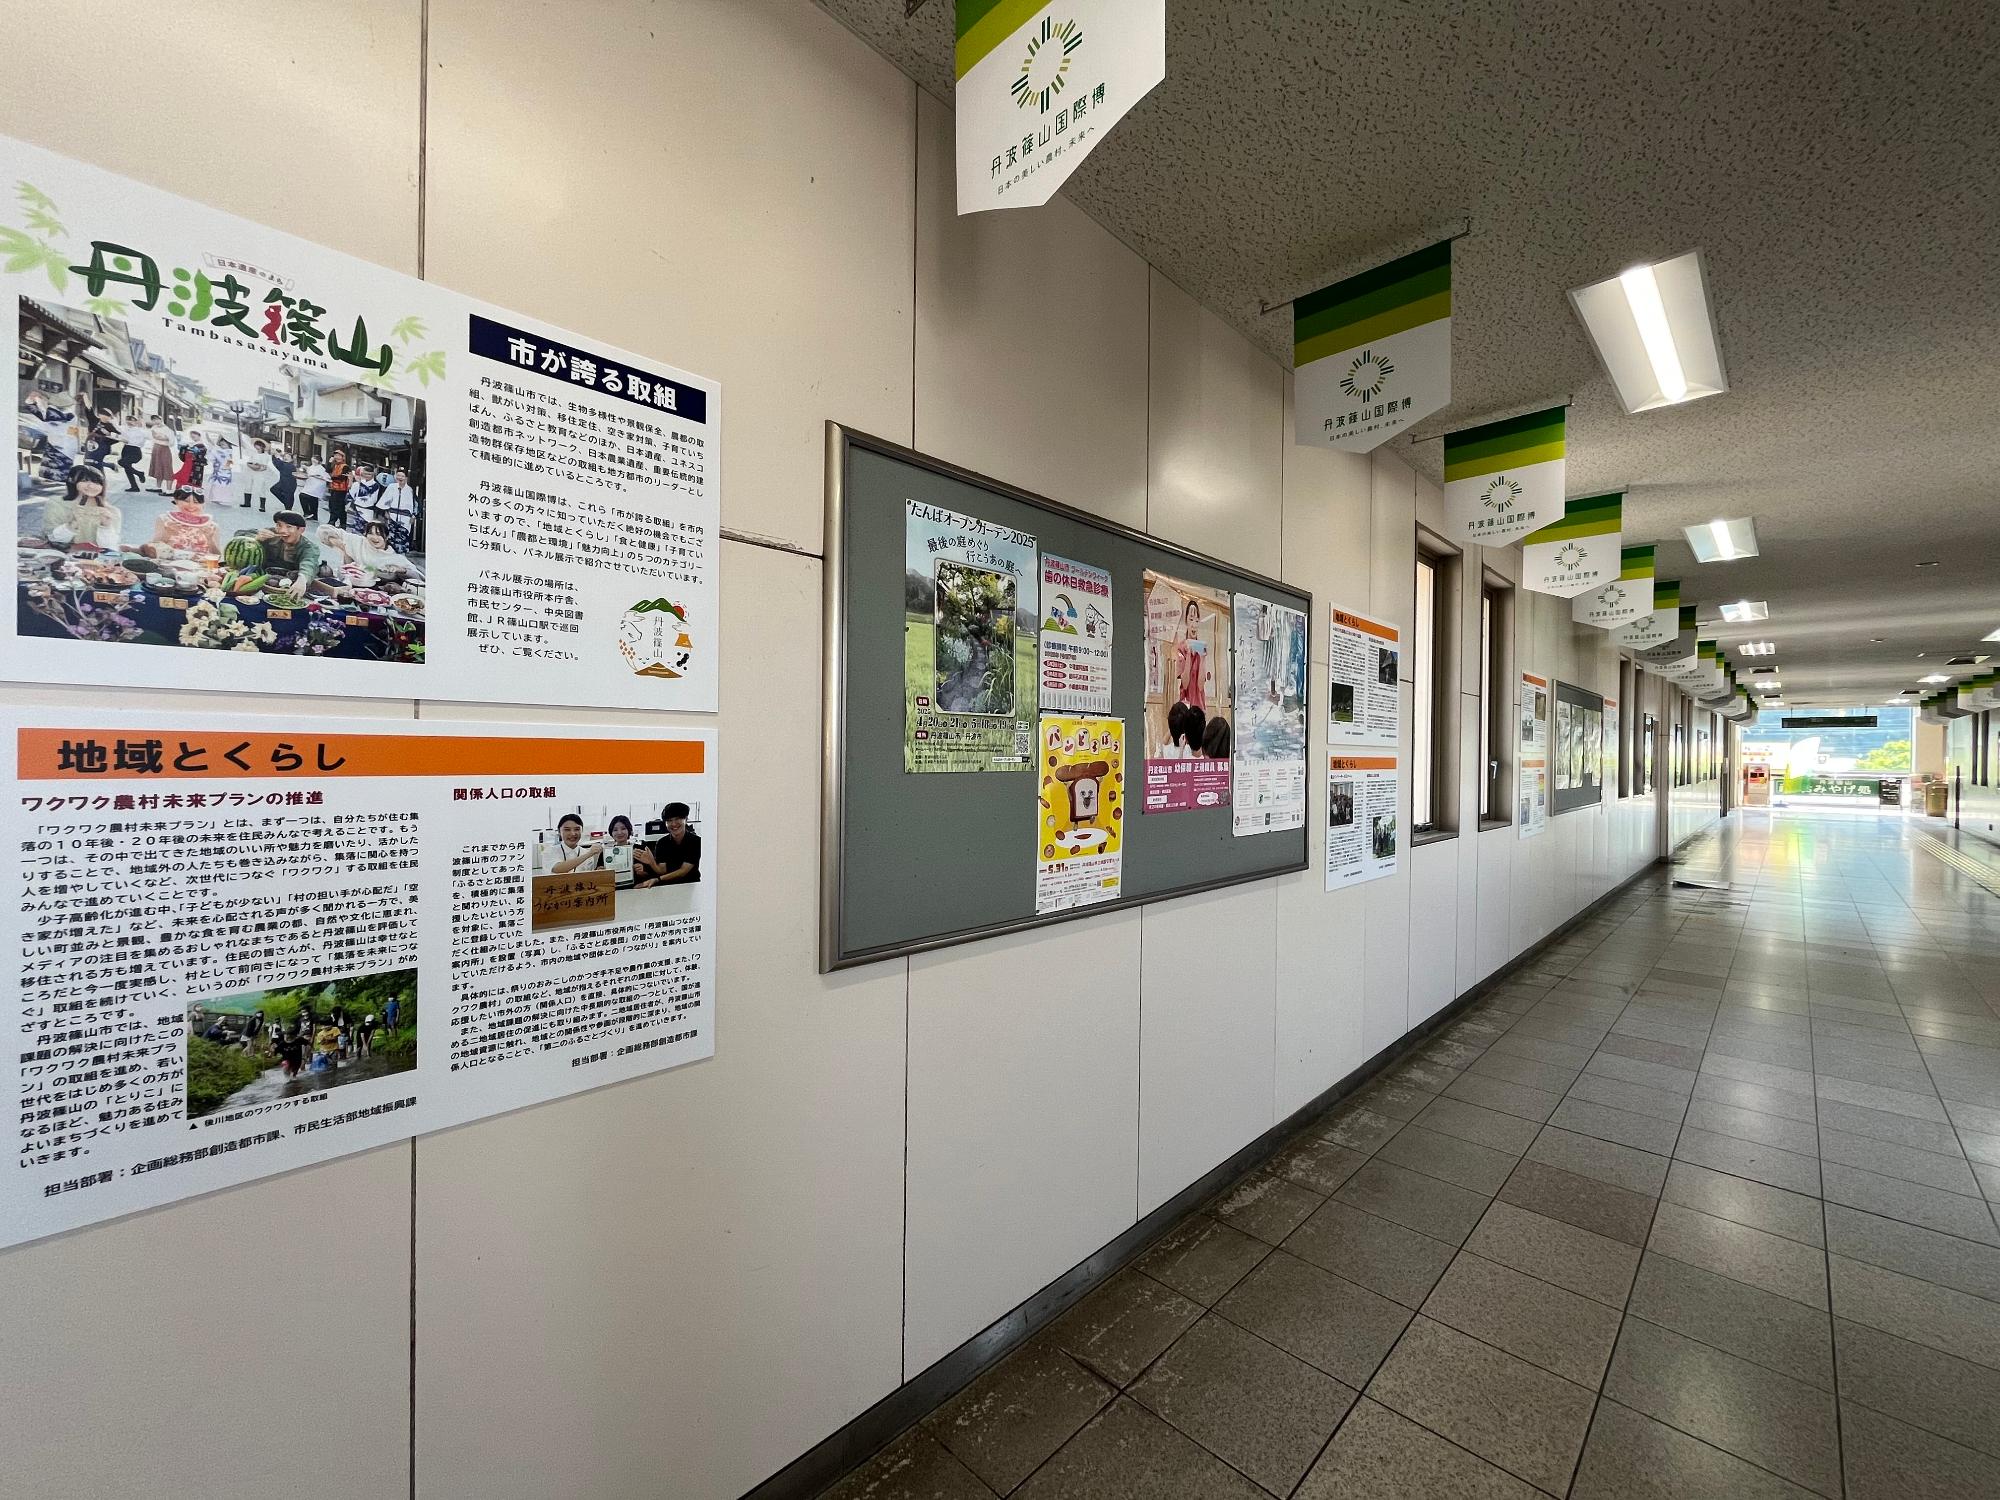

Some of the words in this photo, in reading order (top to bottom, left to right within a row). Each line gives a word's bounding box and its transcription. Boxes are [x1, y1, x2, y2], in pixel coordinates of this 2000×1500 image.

[991, 82, 1106, 179] 丹波篠山国際博
[997, 126, 1095, 195] 日本の美しい農村、未来へ
[217, 259, 284, 285] 日本遺産のまち
[68, 241, 394, 376] 丹波篠山
[162, 317, 330, 370] Tambasasayama
[508, 337, 678, 411] 市が誇る取組
[469, 387, 704, 460] 組、獣がい対策、移住定住、空き家対策、子育ていち
[480, 376, 704, 447] 丹波篠山市では、生物多様性や景観保全、農都の取
[1324, 397, 1412, 431] 丹波篠山国際博
[468, 418, 704, 486] 創造都市ネットワーク、日本農業遺産、重要伝統的建
[469, 402, 704, 473] ばん、ふるさと教育などのほか、日本遺産、ユネスコ
[468, 433, 704, 497] 造物群保存地区などの取組も地方都市のリーダーとし
[469, 449, 628, 493] て積極的に進めているところです。
[468, 493, 704, 547] 外の多くの方々に知っていただく絶好の機会でもござ
[479, 480, 704, 535] 丹波篠山国際博は、これら「市が誇る取組」を市内
[1468, 511, 1536, 530] 丹波篠山国際博
[910, 502, 1034, 548] たんばオープンガーデン2025
[468, 537, 704, 585] に分類し、パネル展示で紹介させていただいています。
[927, 535, 989, 553] 最後の庭めぐり
[966, 550, 1023, 576] 行こうあの庭へ
[468, 583, 580, 605] 丹波篠山市役所本庁舎、
[479, 570, 580, 592] パネル展示の場所は、
[1044, 569, 1109, 598] 歯の休日救急診療
[468, 598, 583, 620] 市民センター、中央図書
[467, 628, 549, 644] 展示しています。
[479, 644, 580, 661] ぜひ、ご覧ください。
[653, 616, 664, 658] 丹波篠山
[58, 739, 346, 774] 地域とくらし
[22, 791, 324, 811] ワクワク農村未来プランの推進
[453, 786, 557, 801] 関係人口の取組
[38, 813, 419, 835] 「ワクワク農村未来プラン」とは、まず一つは、自分たちが住む集
[21, 837, 419, 865] 一つは、その中で出てきた地域のいい所や魅力を磨いたり、活かした
[452, 853, 525, 866] 波篠山市のファン
[462, 842, 525, 853] これまでから丹
[22, 849, 419, 881] りすることで、地域外の人たちも巻き込みながら、集落に関心を持つ
[22, 860, 419, 897] 人を増やしていくなど、次世代につなぐ「ワクワク」する取組を住民
[452, 864, 525, 877] 制度としてあった
[452, 875, 525, 888] 「ふるさと応援団」
[21, 887, 218, 912] みんなで進めていくことです。
[452, 886, 525, 899] を、積極的に集落
[452, 897, 525, 911] と関わりたい、応
[21, 895, 418, 942] き家が増えた」など、未来を心配される声が多く聞かれる一方で、美
[22, 908, 418, 957] しい町並みと景観、豊かな食を育む農業の都、自然や文化に恵まれ、
[452, 908, 525, 923] 援したいという方
[452, 918, 525, 934] を対象に、集落ご
[21, 919, 418, 972] メディアの注目を集めるおしゃれなまちであると丹波篠山を評価して
[452, 930, 523, 945] とに登録していた
[20, 931, 418, 988] 移住される方も増えています。住民の皆さんが、丹波篠山は幸せなと
[22, 943, 418, 1002] ころだと今一度実感し、村として前向きになって「集落を未来につな
[22, 954, 418, 1016] ぐ」取組を続けていく、というのが「ワクワク農村未来プラン」がめ
[452, 982, 474, 992] ます。
[21, 1009, 135, 1033] ざすところです。
[37, 1014, 184, 1045] 丹波篠山市では、地域
[20, 1028, 184, 1063] 課題の解決に向けたこの
[20, 1043, 177, 1077] 「ワクワク農村未来プラ
[20, 1069, 184, 1109] 世代をはじめ多くの方が
[21, 1056, 183, 1093] ン」の取組を進め、若い
[20, 1083, 183, 1124] 丹波篠山の「とりこ」に
[20, 1097, 184, 1138] なるほど、魅力ある住み
[20, 1110, 183, 1153] よいまちづくりを進めて
[20, 1147, 90, 1168] いきます。
